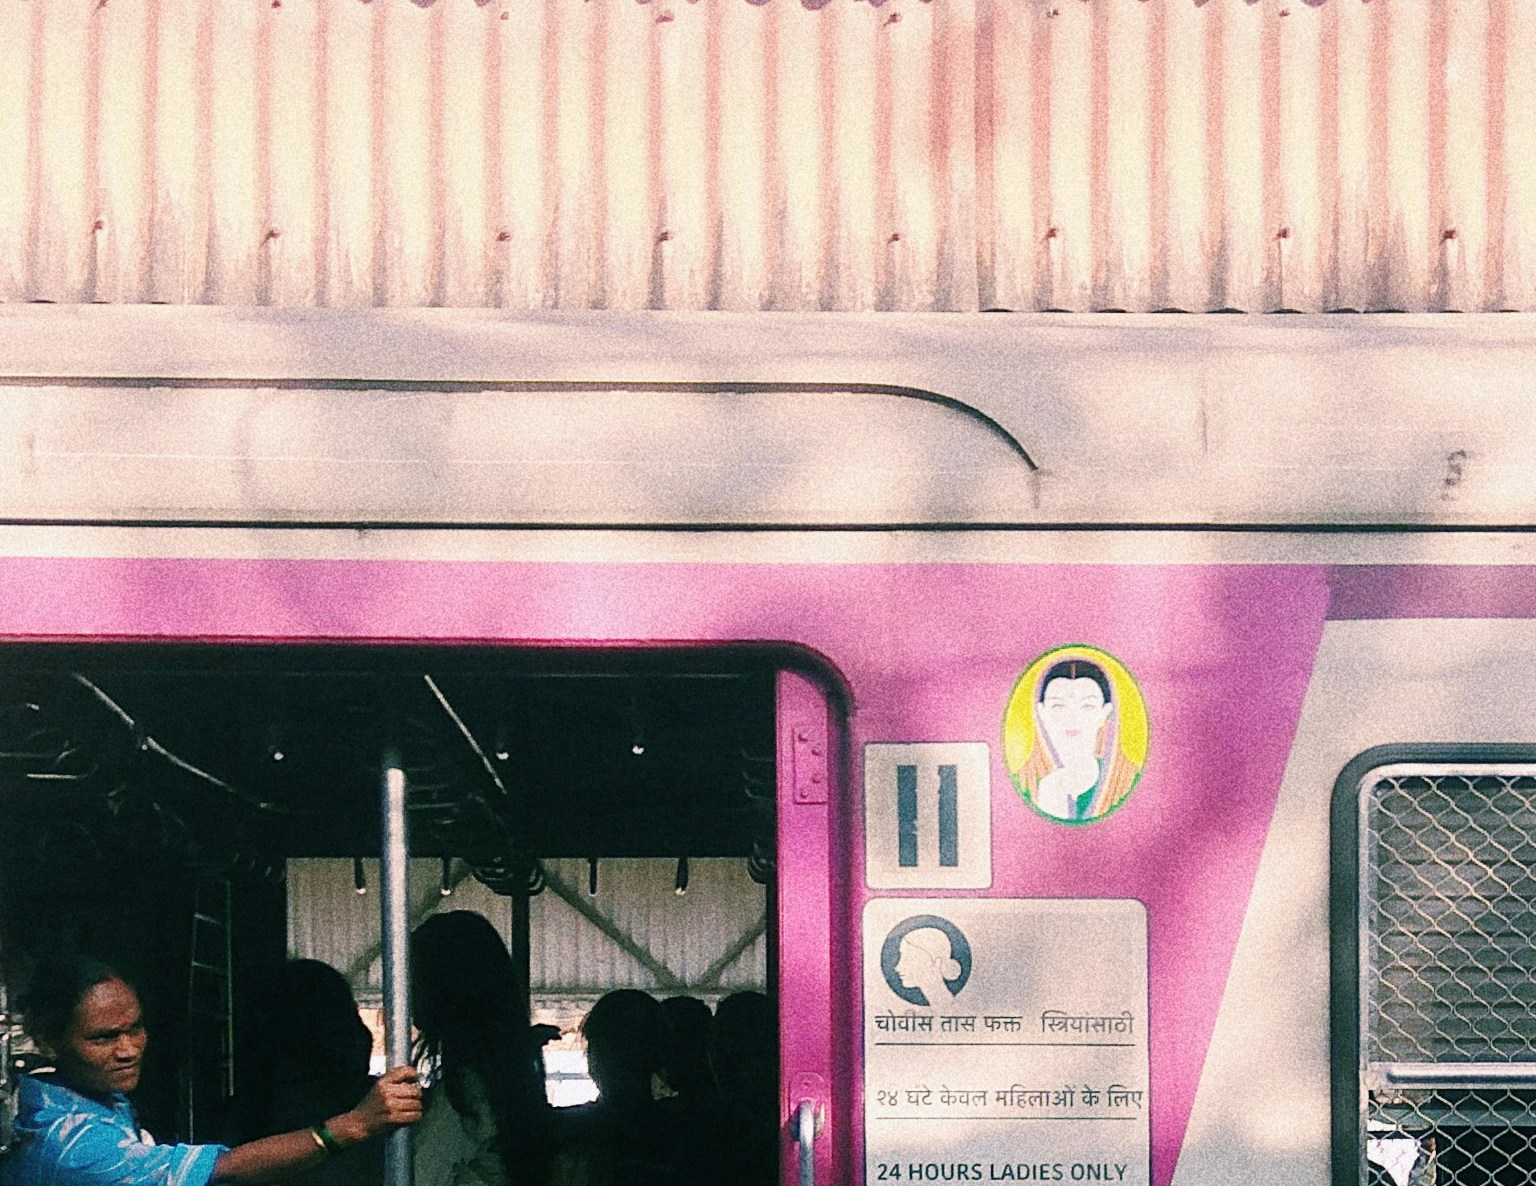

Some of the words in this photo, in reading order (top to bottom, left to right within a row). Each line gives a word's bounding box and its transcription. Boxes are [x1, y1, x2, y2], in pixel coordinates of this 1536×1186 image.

[874, 1008, 934, 1032] चोवीस
[940, 1015, 977, 1032] तास
[983, 1015, 1023, 1032] फक्त
[877, 1090, 898, 1106] २४
[939, 1083, 988, 1106] केवल
[995, 1083, 1076, 1109] महिलाओं
[1081, 1084, 1101, 1107] के
[1107, 1084, 1143, 1110] लिए
[877, 1163, 902, 1182] 24
[908, 1163, 982, 1182] HOURS
[989, 1163, 1064, 1182] LADIES
[1070, 1163, 1128, 1182] ONLY
